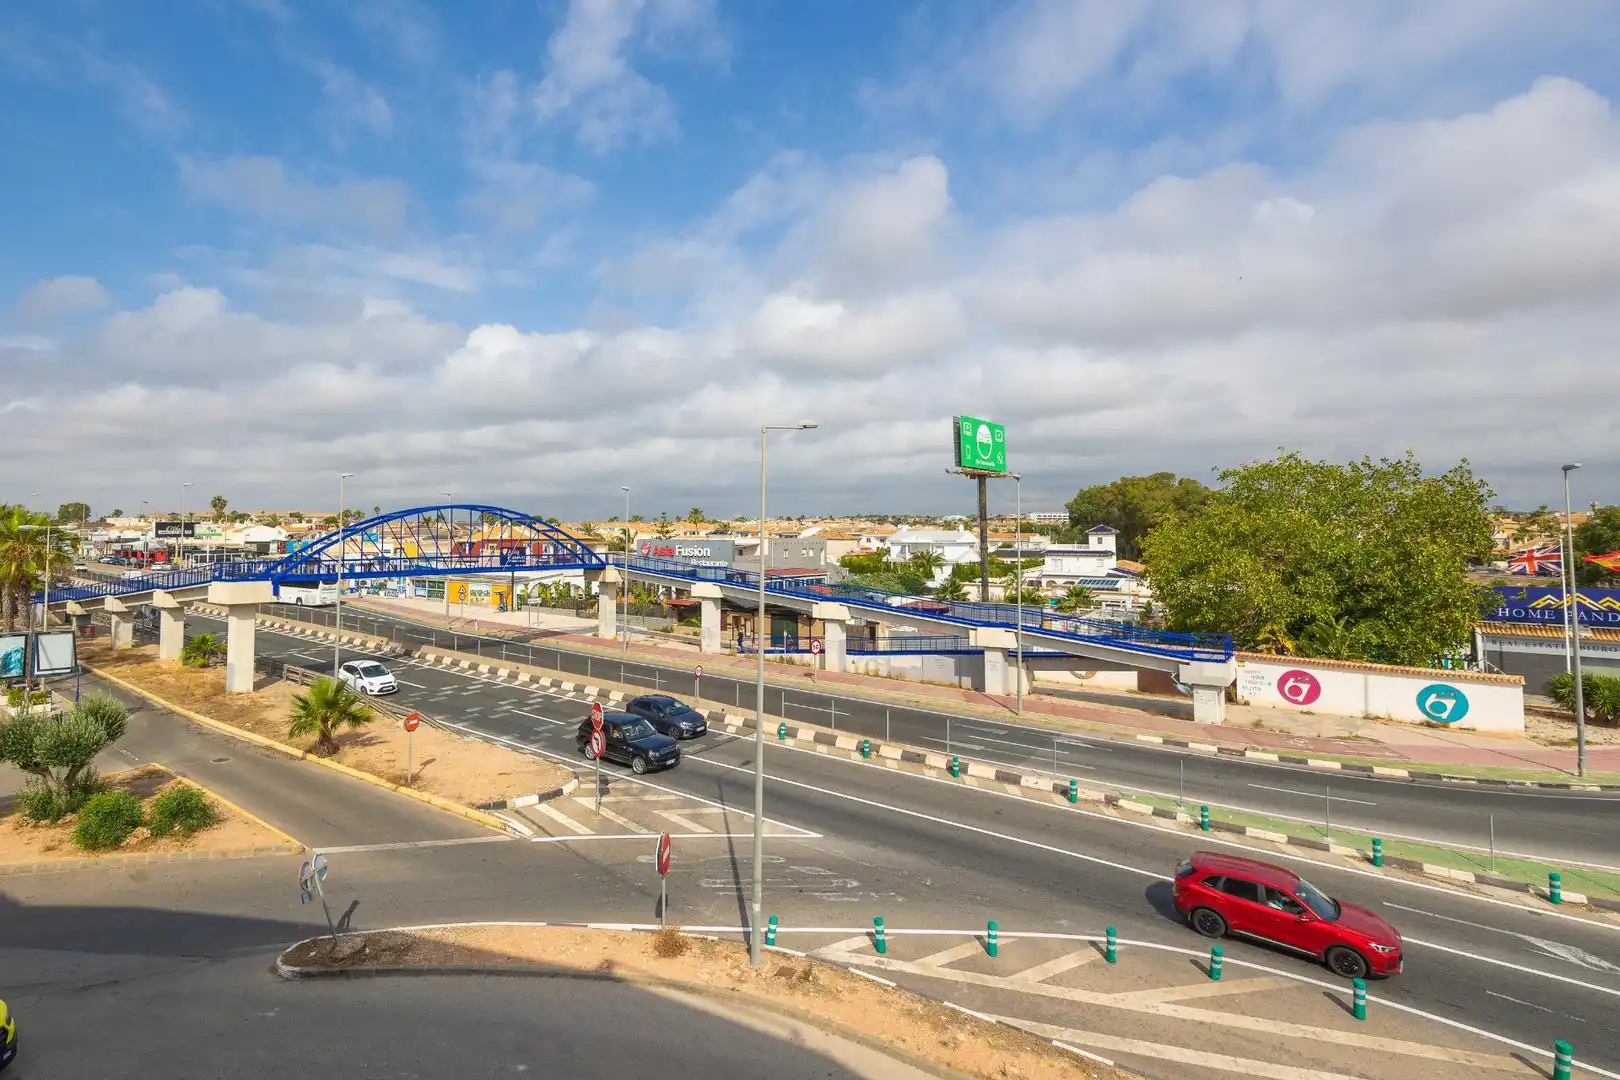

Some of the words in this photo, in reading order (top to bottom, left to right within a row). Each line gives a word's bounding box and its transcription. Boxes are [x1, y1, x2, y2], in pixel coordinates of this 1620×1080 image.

[653, 544, 675, 557] Asia
[675, 545, 711, 558] Fusion
[691, 559, 729, 568] Restaurante
[1498, 607, 1556, 620] HOME
[1491, 639, 1517, 648] REAL
[591, 708, 602, 722] STOP
